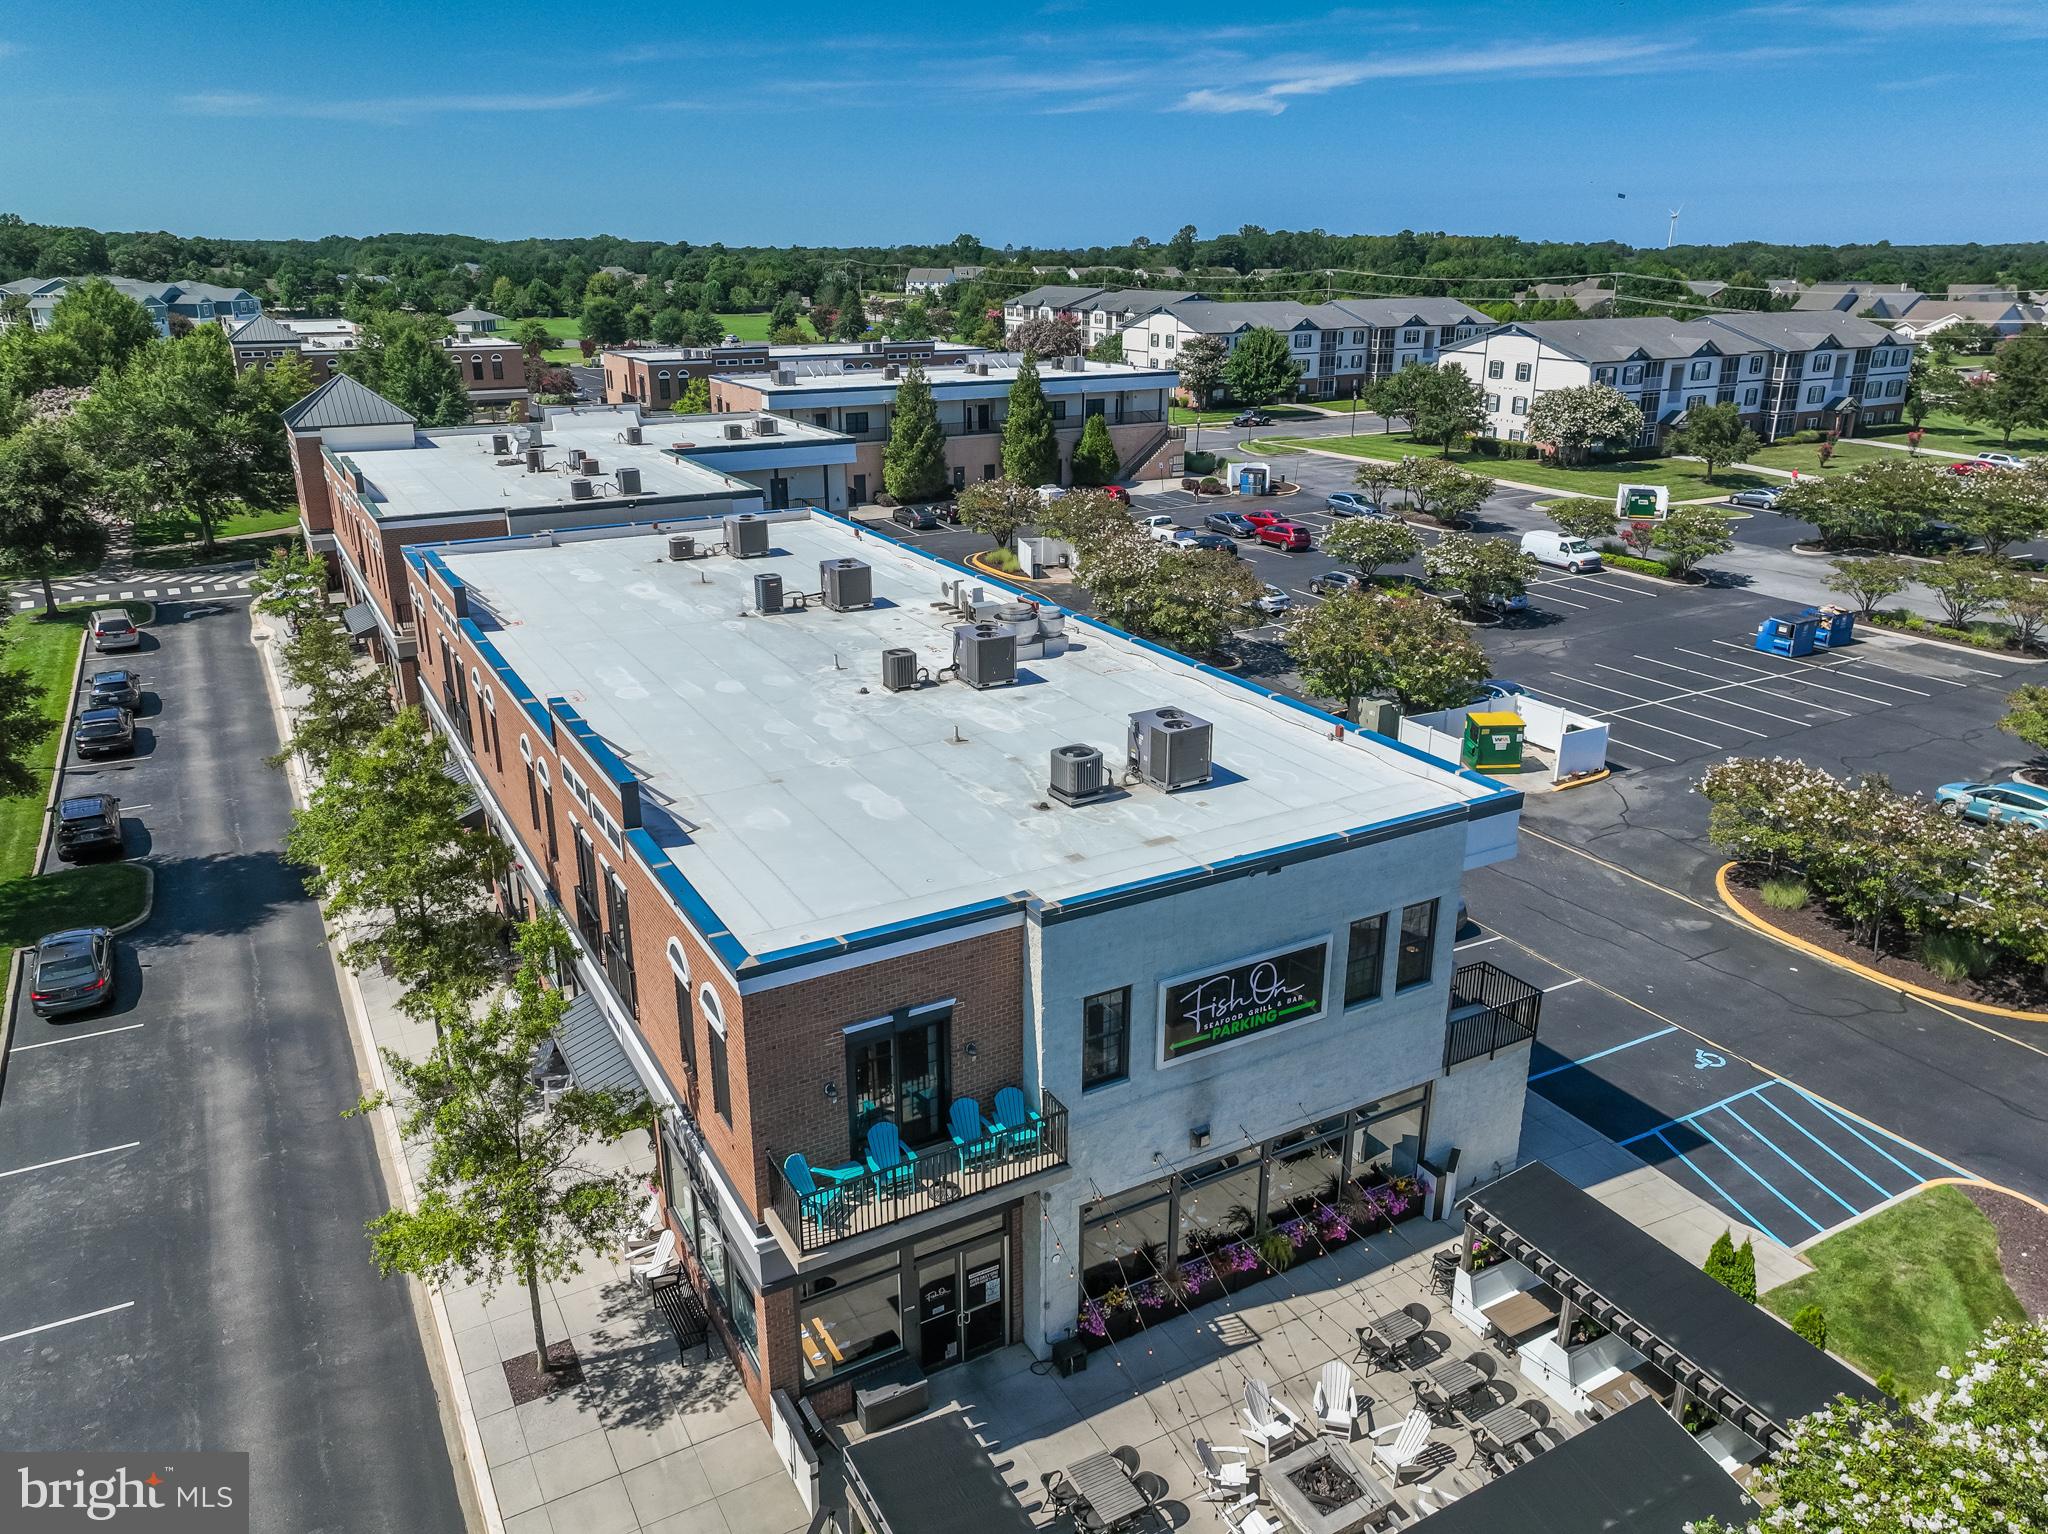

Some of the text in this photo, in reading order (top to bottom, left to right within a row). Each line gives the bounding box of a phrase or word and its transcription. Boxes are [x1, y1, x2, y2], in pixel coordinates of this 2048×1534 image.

[1180, 961, 1305, 1033] Fish On
[1203, 1013, 1244, 1031] SEAFOOD
[1248, 1004, 1272, 1016] GRILL
[1286, 994, 1303, 1005] BAR
[1212, 1009, 1278, 1040] PARKING
